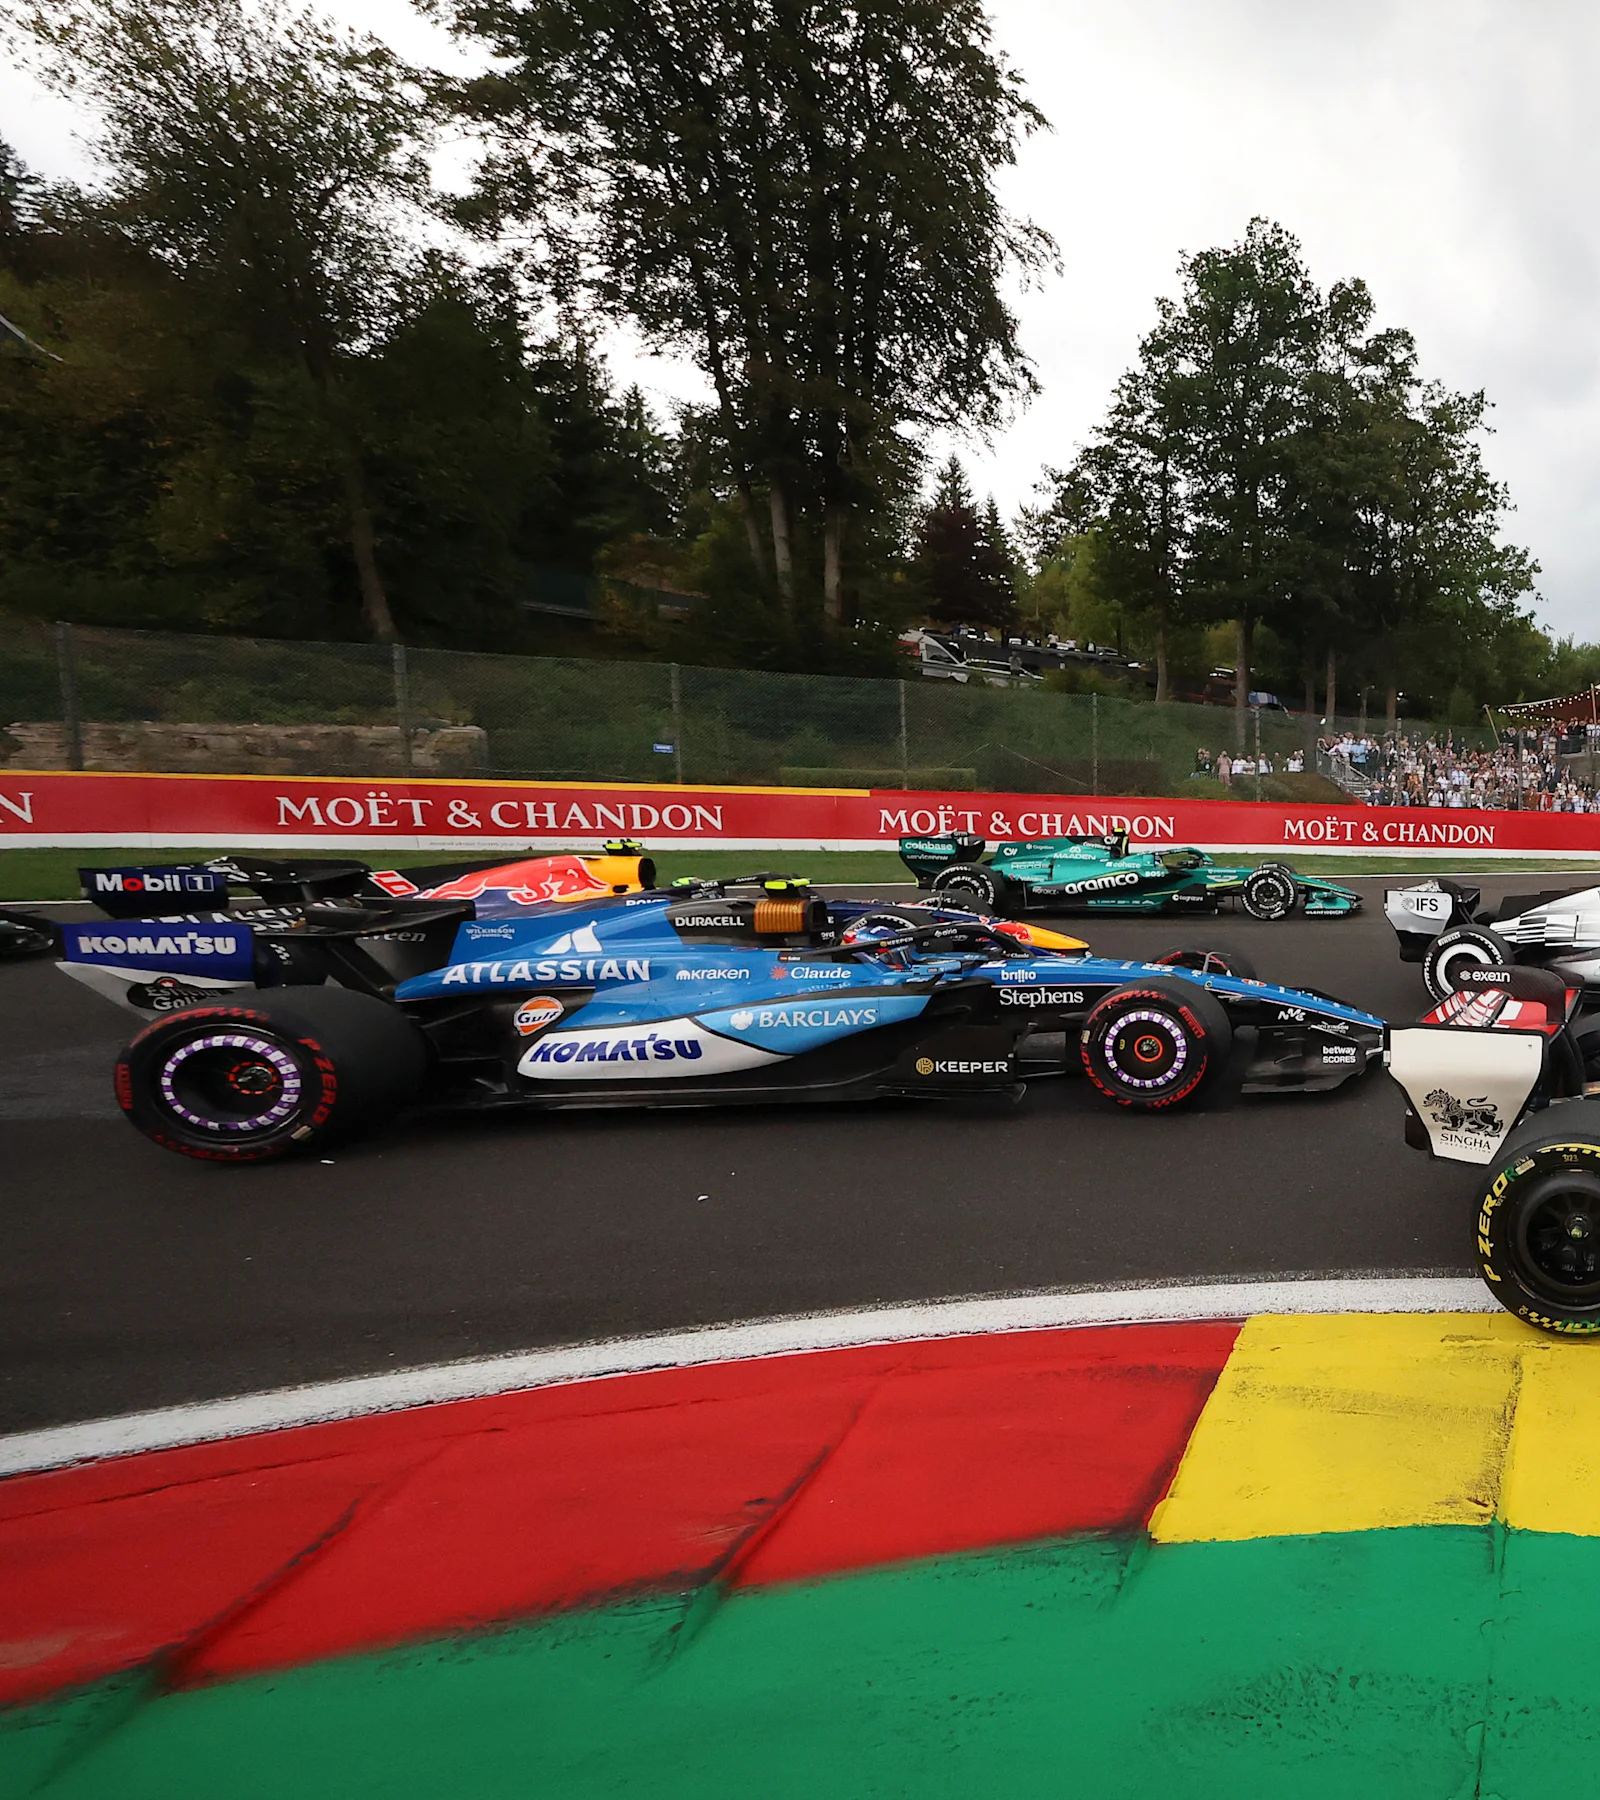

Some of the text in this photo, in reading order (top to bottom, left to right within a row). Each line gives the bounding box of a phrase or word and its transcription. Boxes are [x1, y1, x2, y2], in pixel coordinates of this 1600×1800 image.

[276, 791, 723, 831] MOËT & CHANDON
[879, 805, 1174, 838] MOËT & CHANDON
[1283, 816, 1495, 844] MOËT & CHANDON
[905, 841, 953, 851] coinbase
[95, 873, 181, 891] Mobil
[1064, 872, 1139, 894] aramco
[1416, 898, 1438, 911] IFS
[675, 916, 745, 927] DURACELL
[466, 927, 516, 935] WILKINSON
[1438, 931, 1461, 947] PIRELLI
[78, 932, 236, 954] KOMATSU
[442, 959, 650, 984] ATLASSIAN
[790, 967, 851, 980] Claude
[1472, 971, 1511, 982] exein
[1000, 987, 1084, 1008] Stephens
[517, 1009, 561, 1024] Gulf
[759, 1009, 876, 1028] BARCLAYS
[1178, 1005, 1206, 1039] PIRELLI
[529, 1034, 703, 1063] KOMATSU
[1323, 1045, 1356, 1056] betway
[935, 1060, 1008, 1073] KEEPER
[1323, 1055, 1356, 1064] SCORES
[1440, 1133, 1491, 1150] SINGHA
[1478, 1172, 1508, 1257] ZERO
[1483, 1263, 1501, 1281] P
